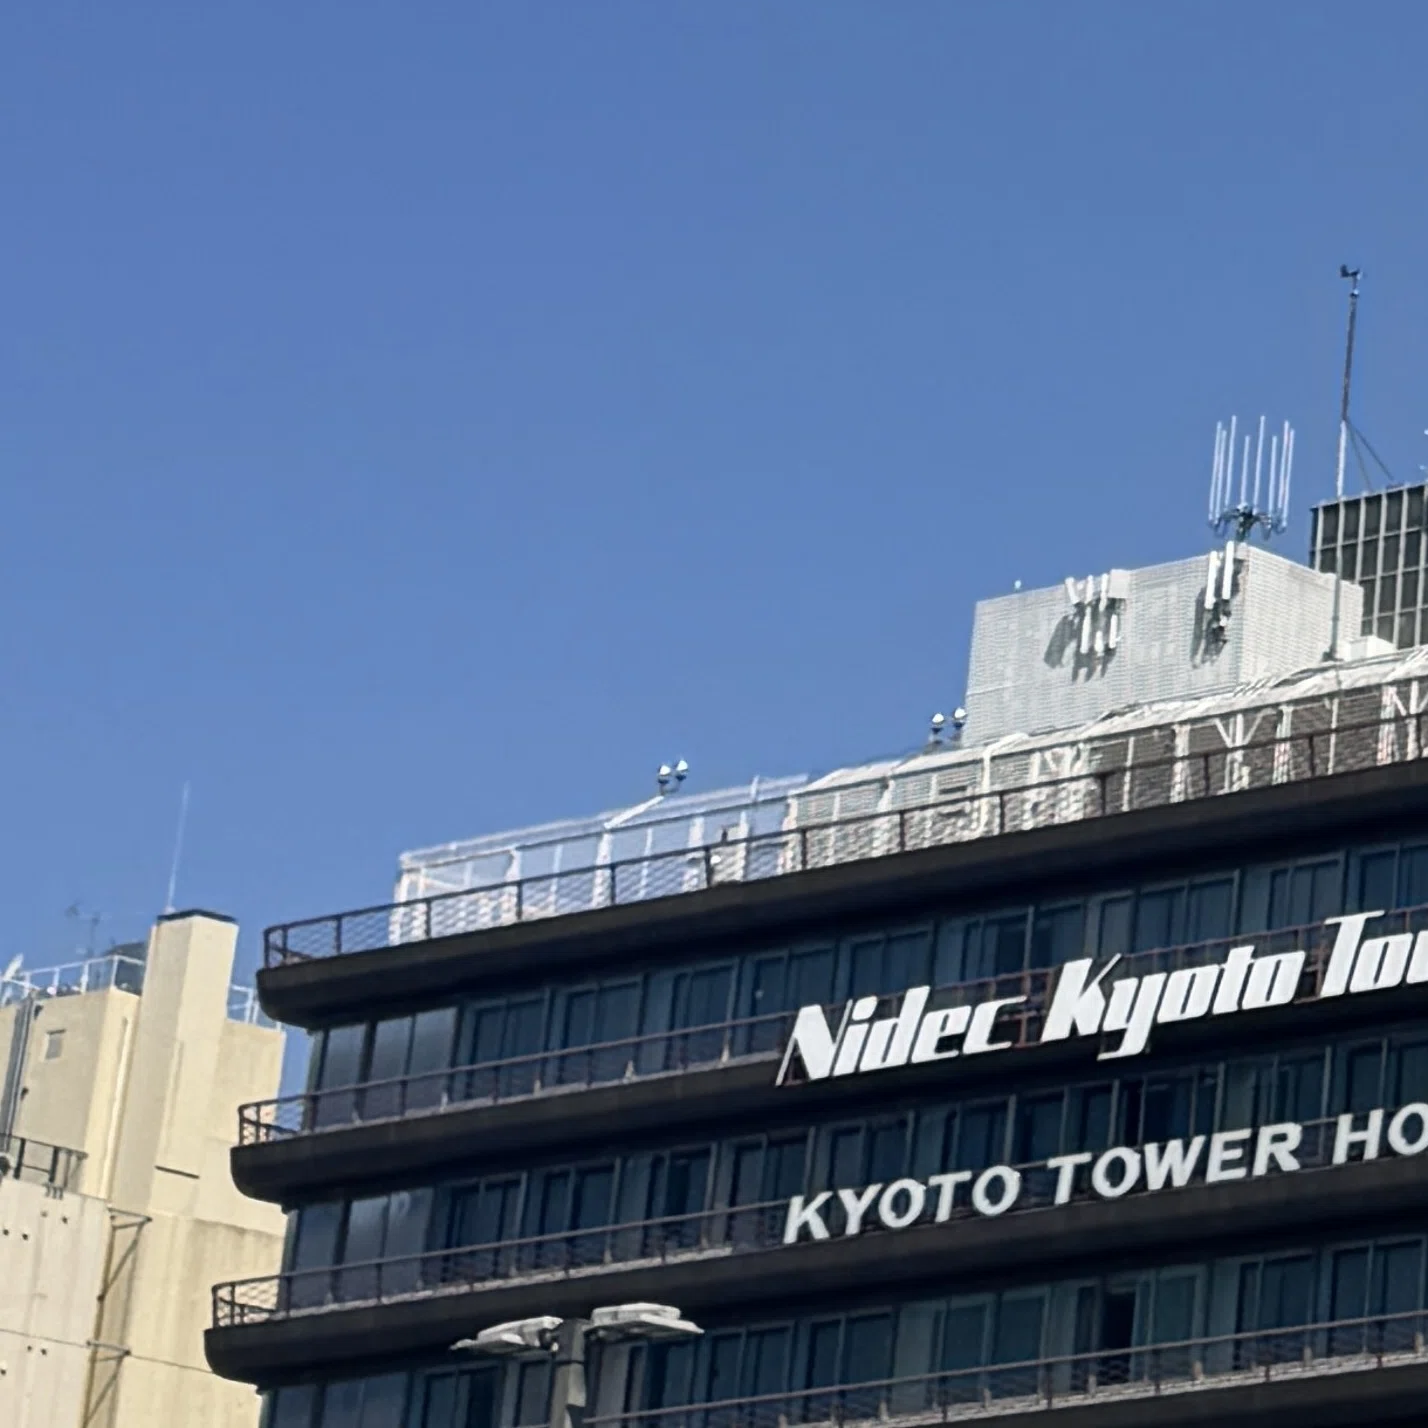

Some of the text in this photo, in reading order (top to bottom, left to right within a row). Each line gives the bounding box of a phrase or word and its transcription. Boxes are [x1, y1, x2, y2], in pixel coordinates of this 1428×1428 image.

[775, 985, 1026, 1087] Nidec
[1040, 943, 1306, 1061] Kyoto
[783, 1165, 1020, 1245] KYOTO
[1047, 1122, 1301, 1199] TOWER
